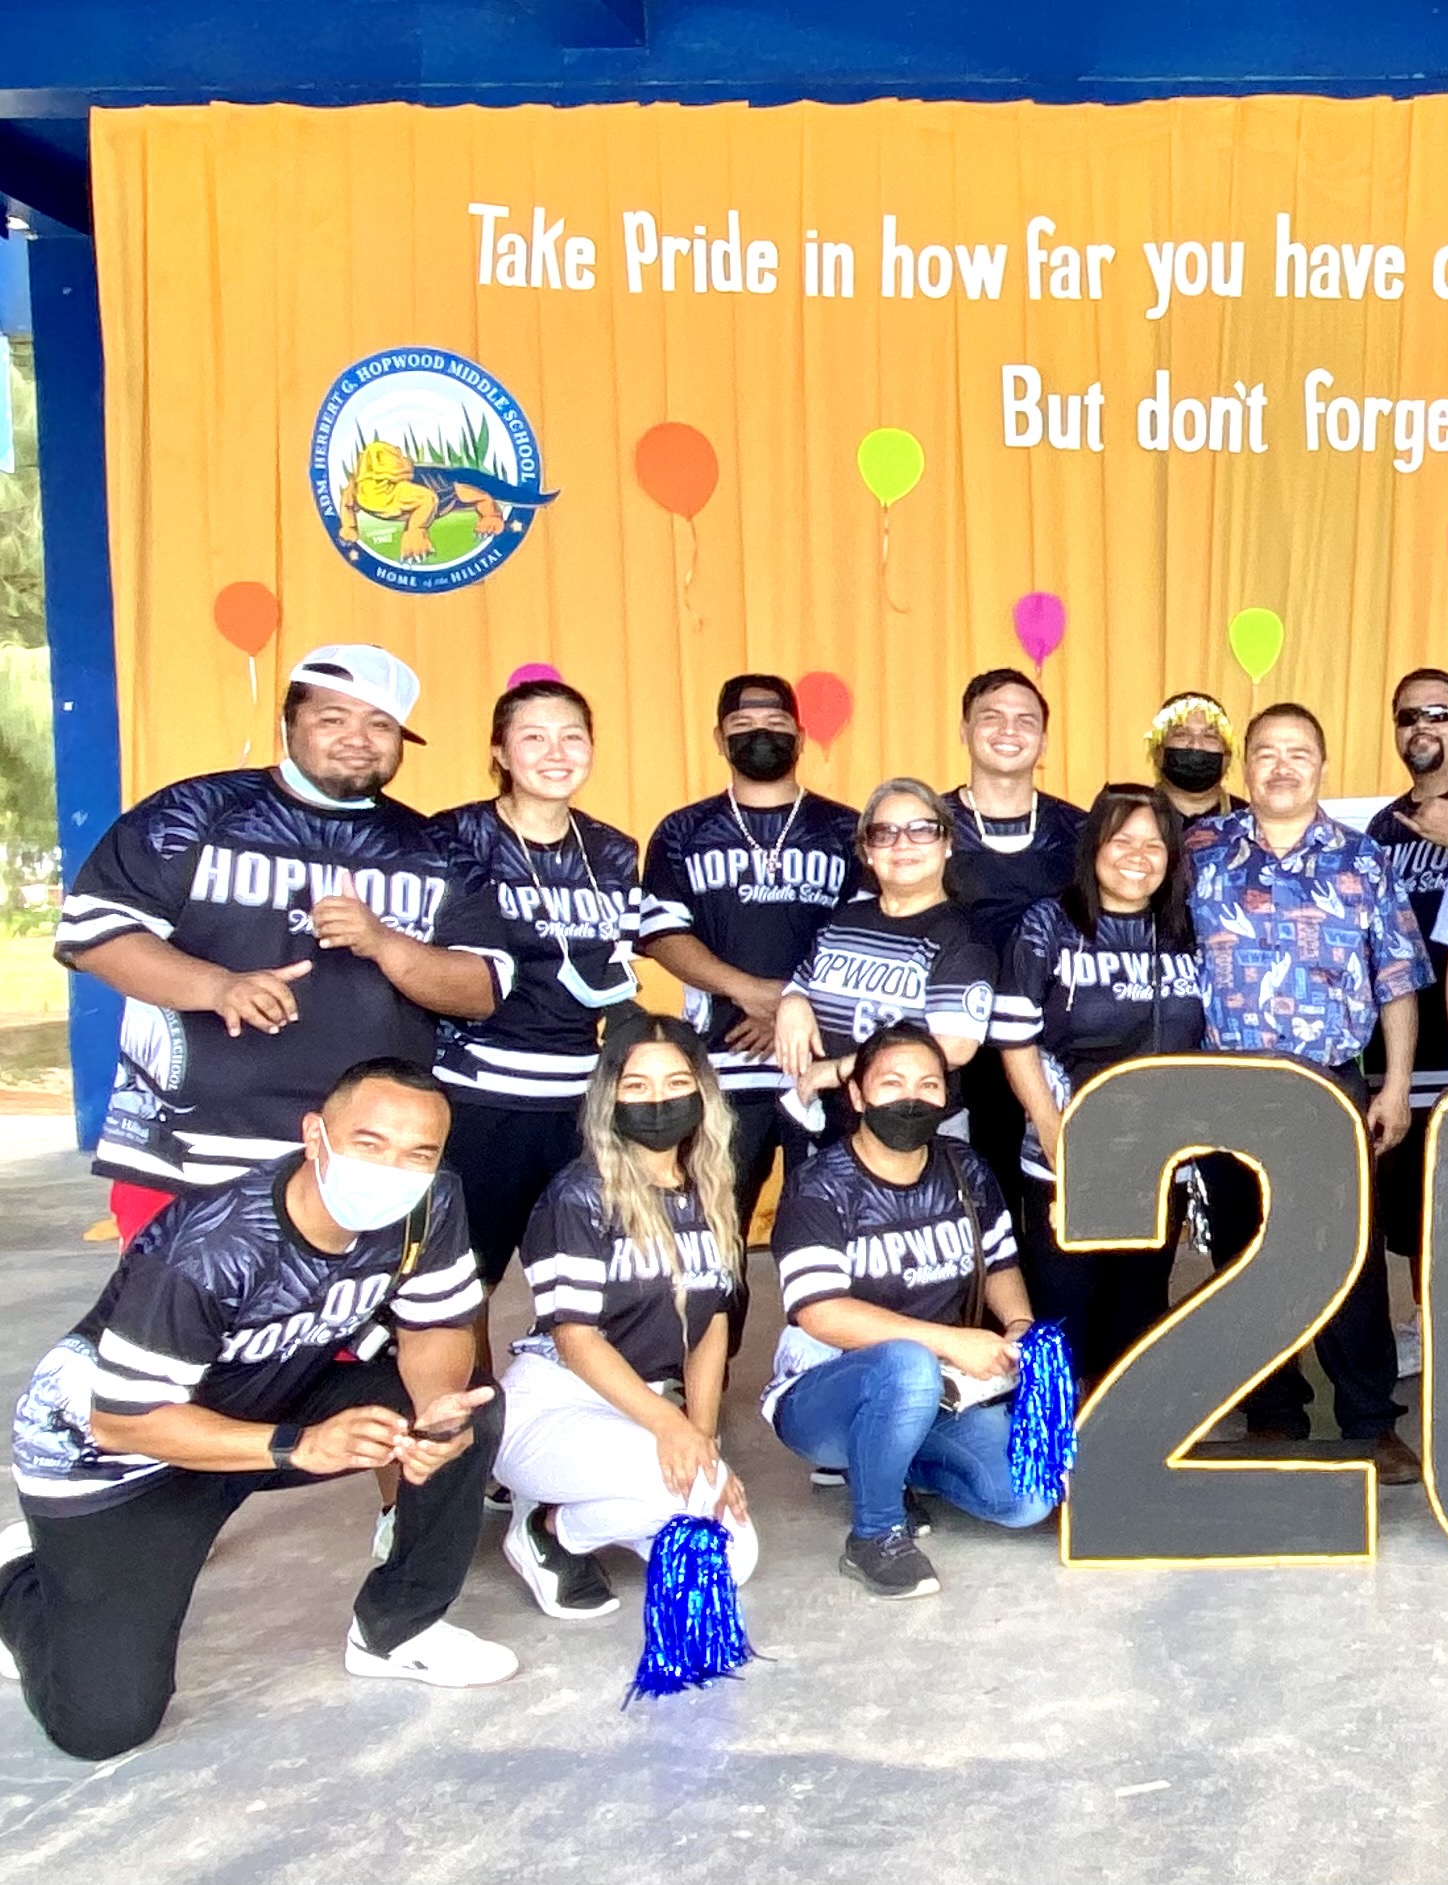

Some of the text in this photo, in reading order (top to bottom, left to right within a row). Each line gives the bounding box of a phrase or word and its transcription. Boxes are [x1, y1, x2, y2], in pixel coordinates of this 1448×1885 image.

[468, 202, 596, 291] Take
[622, 209, 778, 295] Pride
[804, 229, 854, 299] in
[881, 214, 1008, 301] how
[1026, 215, 1116, 300] far
[1144, 241, 1244, 320] you
[1275, 212, 1406, 300] have
[314, 390, 346, 469] HERBERT
[355, 353, 445, 382] HOPWOOD
[447, 359, 510, 411] MIDDLE
[502, 409, 537, 483] SCHOOL
[1002, 364, 1105, 452] But
[1136, 369, 1269, 454] don't
[376, 566, 418, 587] HOME
